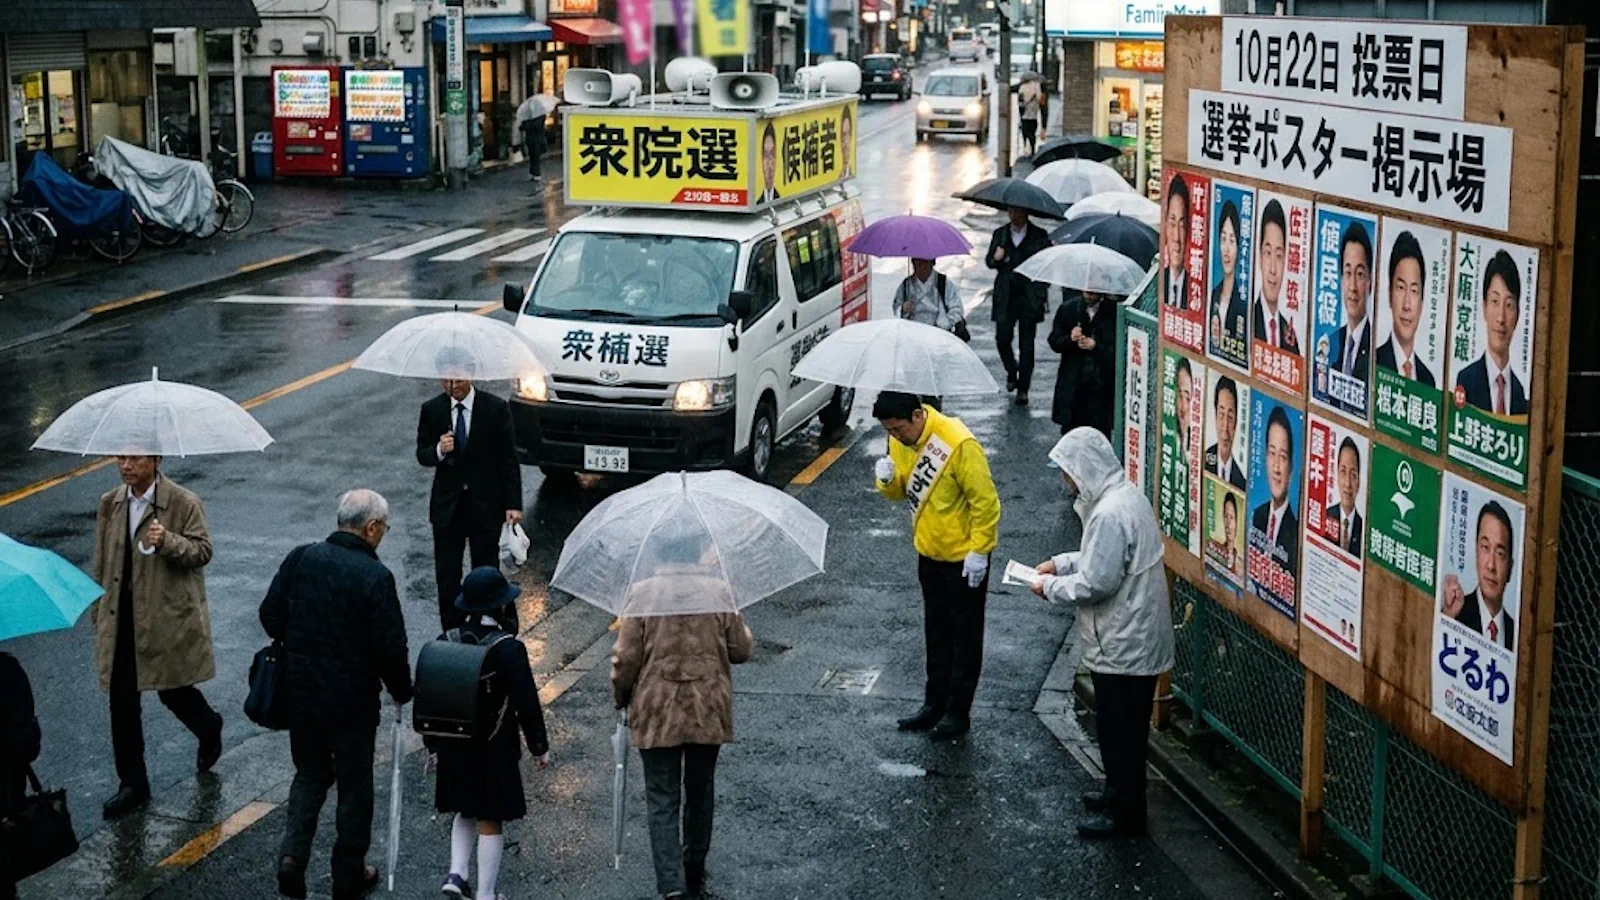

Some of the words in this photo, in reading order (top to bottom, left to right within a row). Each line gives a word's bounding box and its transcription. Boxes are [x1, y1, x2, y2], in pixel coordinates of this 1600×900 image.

[1235, 29, 1339, 93] 10月22日
[1352, 33, 1445, 103] 投票日
[579, 124, 740, 181] 衆院選
[782, 122, 837, 185] 候補者
[1201, 99, 1487, 214] 選挙ポスター掲示場
[1438, 632, 1511, 704] どるわ
